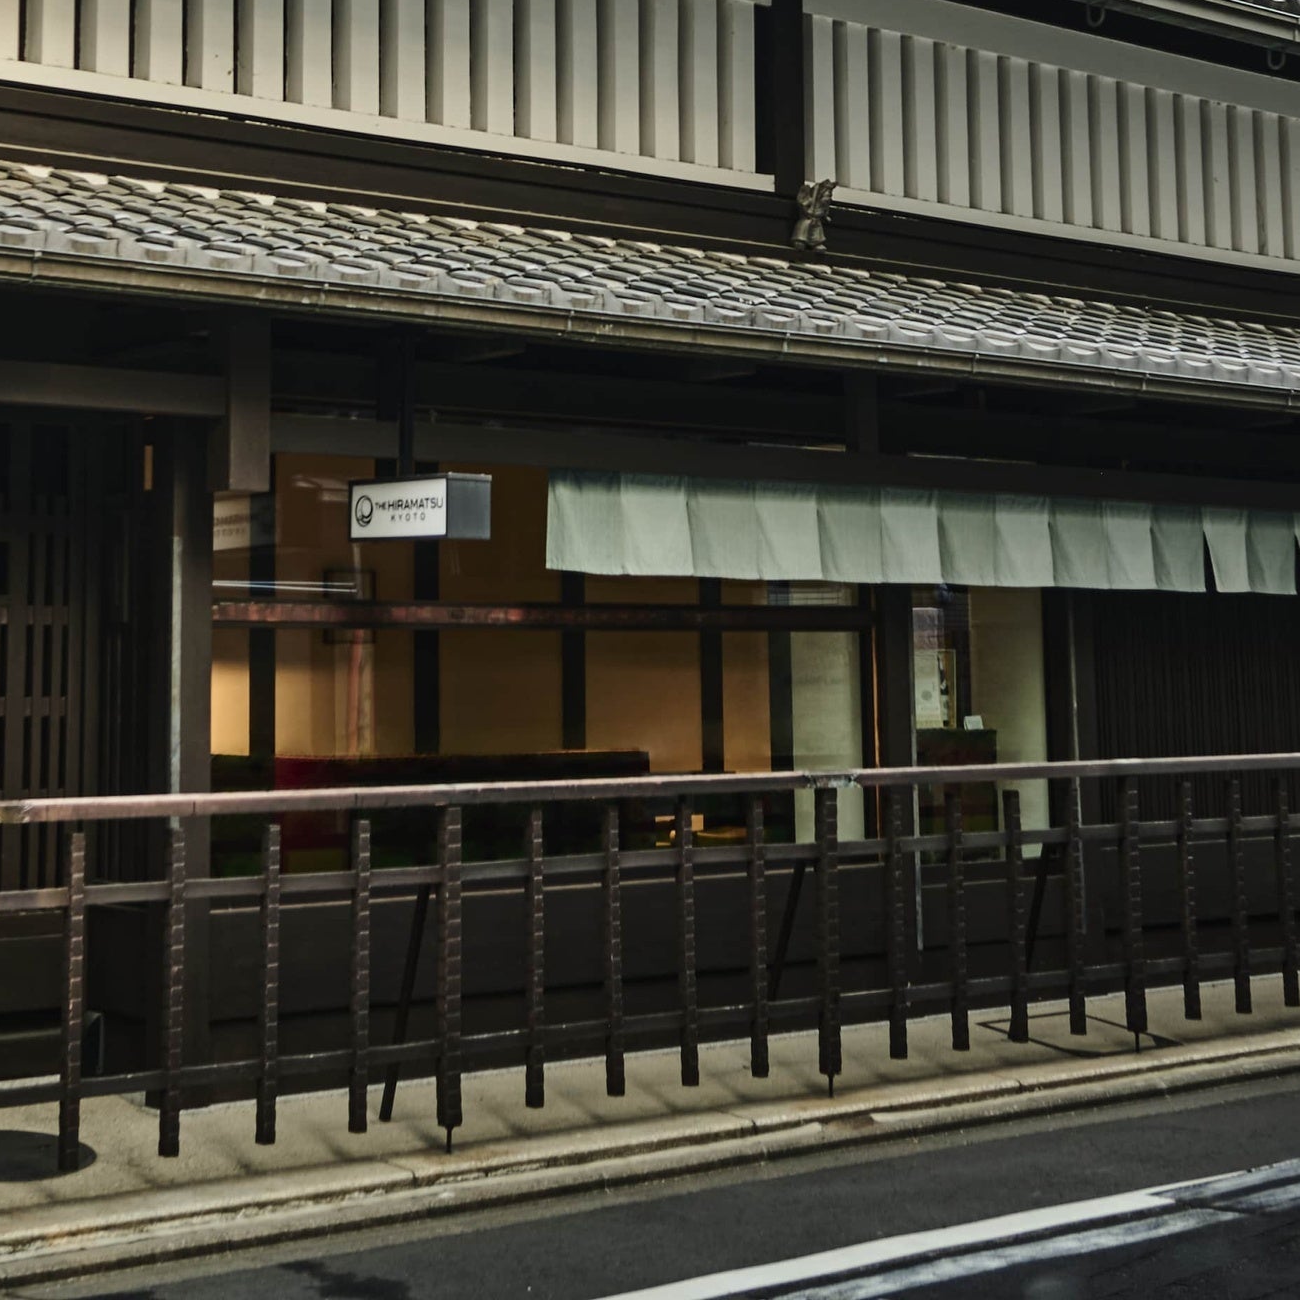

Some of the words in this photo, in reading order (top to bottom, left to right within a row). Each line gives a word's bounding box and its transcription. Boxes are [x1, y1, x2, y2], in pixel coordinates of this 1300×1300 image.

[375, 502, 387, 511] THE
[388, 498, 443, 511] HIRAMATSU
[391, 513, 426, 522] KYOTO
